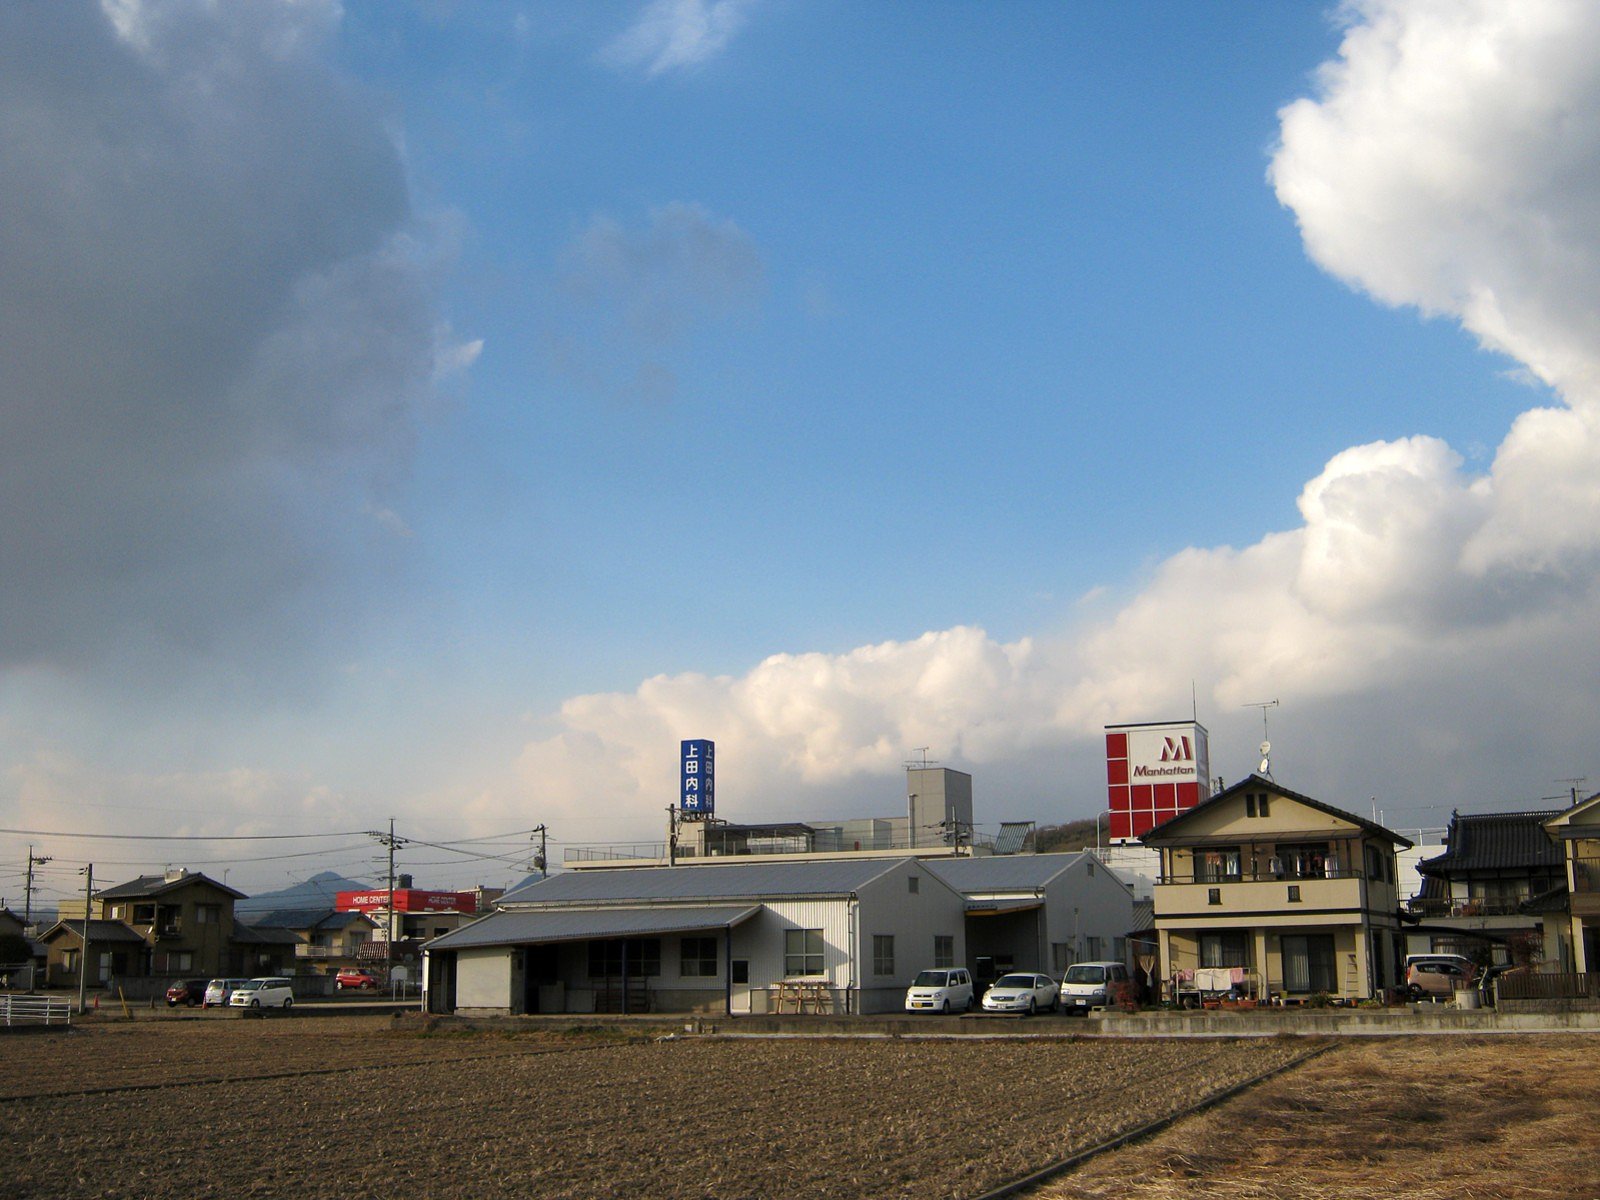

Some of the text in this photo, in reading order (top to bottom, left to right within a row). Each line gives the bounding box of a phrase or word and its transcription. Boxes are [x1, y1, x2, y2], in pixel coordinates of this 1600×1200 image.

[1159, 735, 1192, 762] M
[685, 744, 699, 808] 上田内科
[705, 744, 713, 808] 上田内科
[1133, 765, 1195, 777] Manhattan
[352, 896, 368, 904] HOME
[428, 896, 440, 904] HOME
